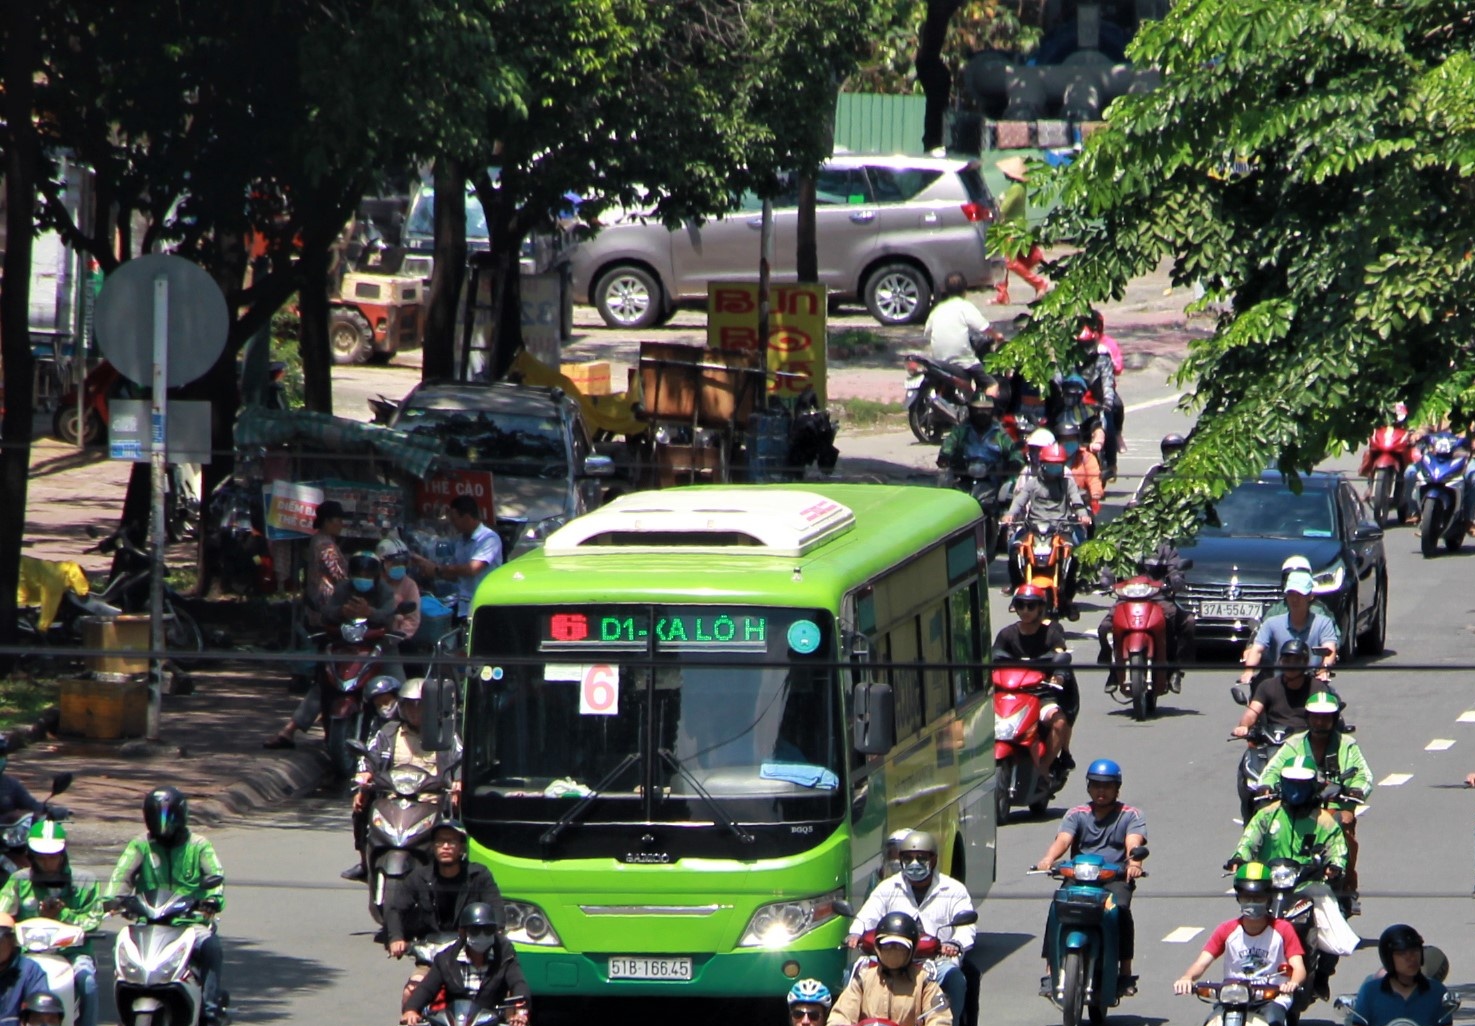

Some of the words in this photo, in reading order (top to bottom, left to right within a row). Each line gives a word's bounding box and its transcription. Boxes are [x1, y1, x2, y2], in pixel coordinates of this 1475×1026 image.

[551, 613, 588, 641] 6
[583, 663, 615, 712] 6
[611, 960, 689, 976] 51B-166.45
